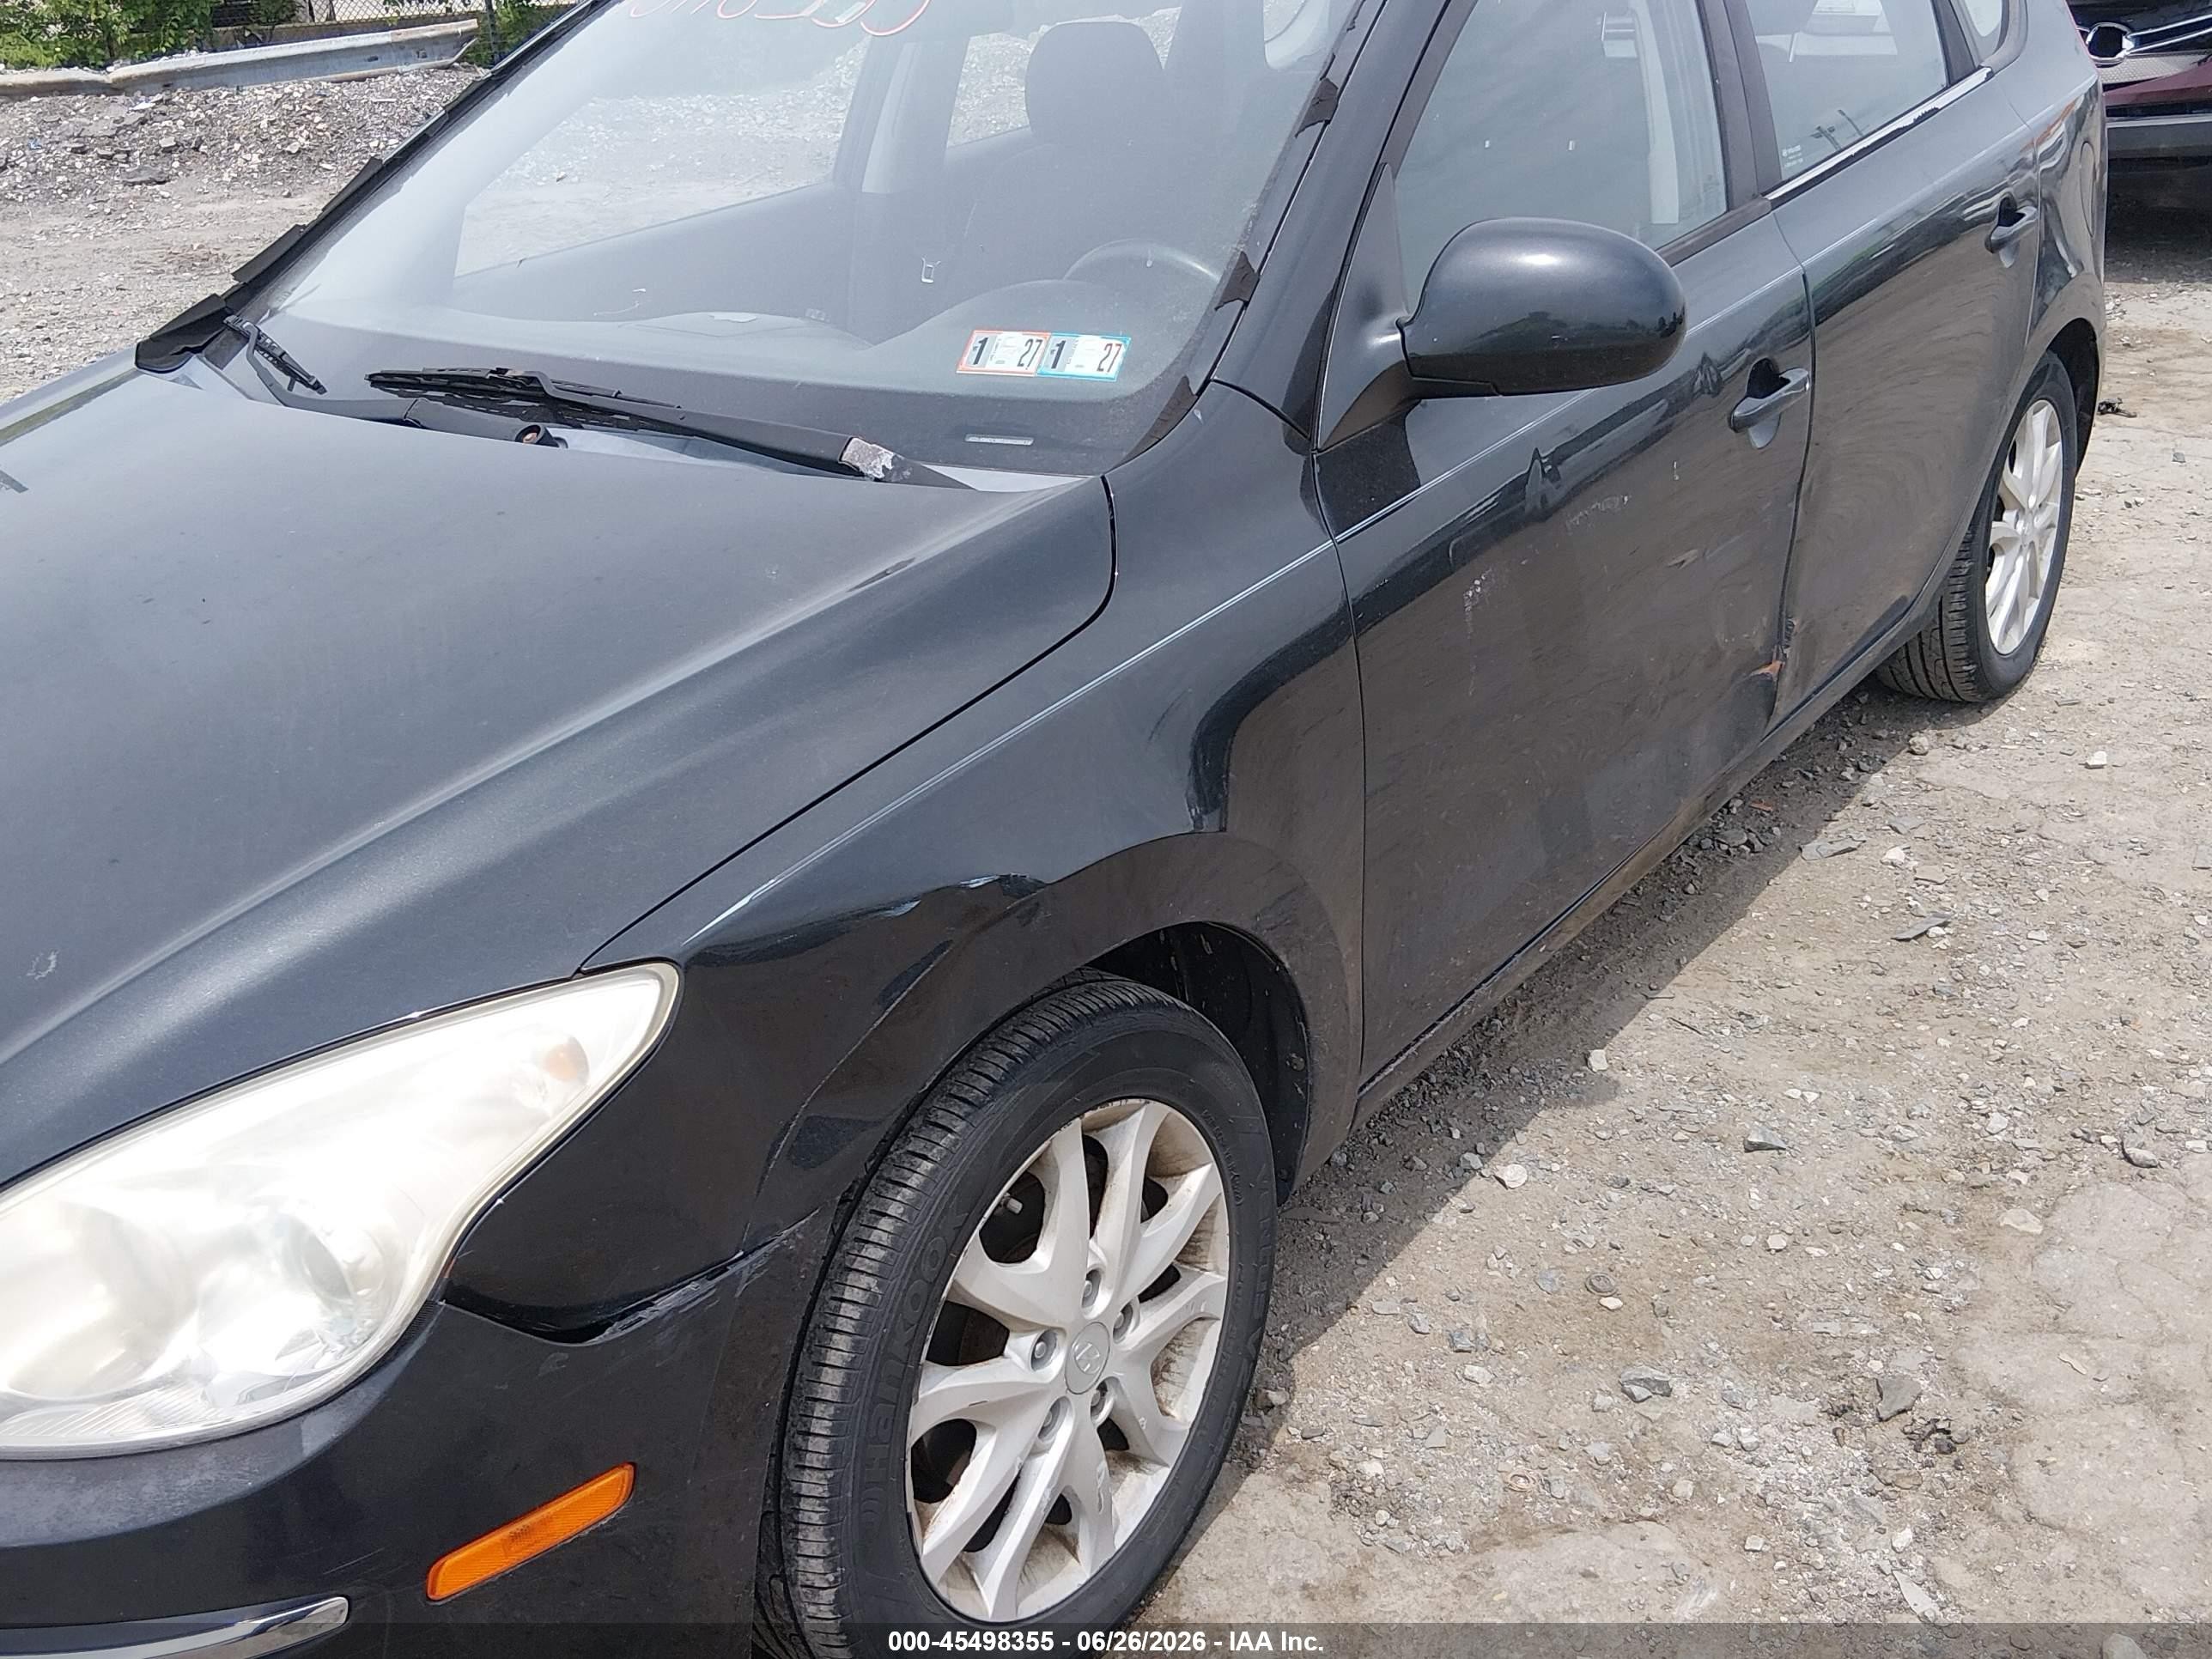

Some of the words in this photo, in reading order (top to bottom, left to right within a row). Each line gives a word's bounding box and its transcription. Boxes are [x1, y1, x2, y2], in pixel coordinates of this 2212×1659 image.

[972, 337, 989, 366] 1
[1017, 338, 1044, 369] 27
[1050, 340, 1066, 369] 1
[1097, 343, 1123, 373] 27
